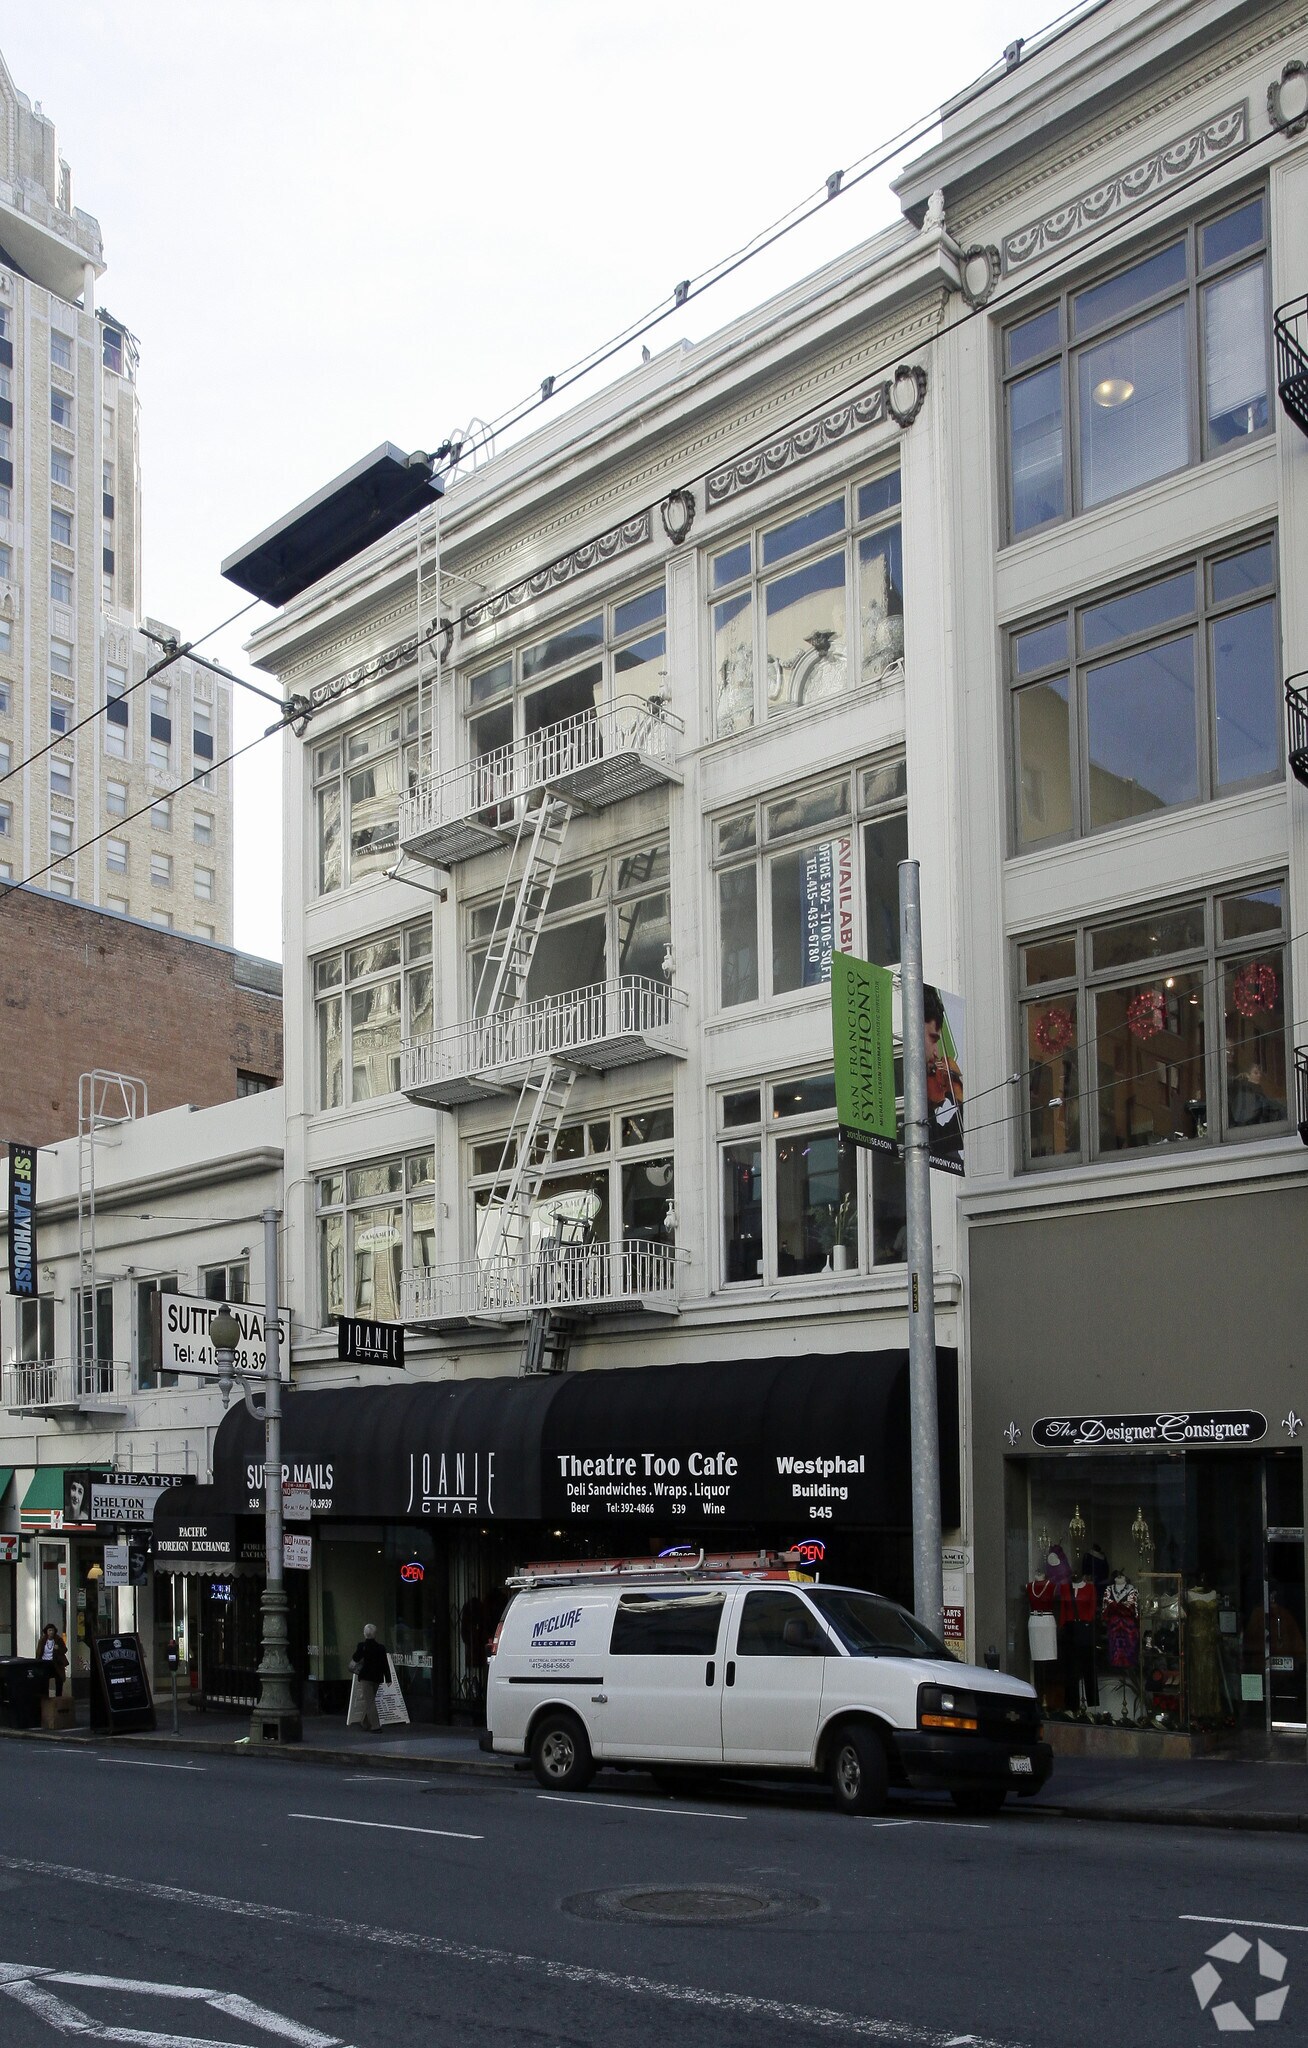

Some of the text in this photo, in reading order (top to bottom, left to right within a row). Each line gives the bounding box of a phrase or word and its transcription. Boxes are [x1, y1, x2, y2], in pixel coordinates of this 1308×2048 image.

[819, 843, 831, 881] OFFICE
[846, 970, 860, 1120] SAN FRANCISCO
[857, 972, 875, 1125] SYMPHONY
[15, 1147, 32, 1155] THE
[14, 1156, 31, 1181] SF
[14, 1181, 33, 1293] PLAYHOUSE
[173, 1343, 194, 1363] Tel:
[355, 1350, 389, 1360] CHAR
[1045, 1414, 1251, 1445] The Designer Consigner
[557, 1451, 739, 1477] Theatre Too Cafe
[776, 1454, 866, 1478] Westphal
[102, 1473, 183, 1487] THEATRE
[293, 1464, 334, 1490] NAILS
[282, 1488, 291, 1496] NO
[566, 1482, 731, 1500] Deli Sandwiches Wraps Liquor
[792, 1483, 849, 1500] Building
[93, 1496, 144, 1509] SHELTON
[249, 1499, 260, 1509] 535
[421, 1502, 479, 1514] CHAR
[570, 1502, 590, 1513] Beer
[671, 1503, 686, 1514] 539
[702, 1502, 726, 1514] Wine
[93, 1508, 145, 1520] THEATER
[808, 1506, 833, 1519] 545
[178, 1526, 208, 1538] PACIFIC
[157, 1540, 231, 1553] FOREIGN EXCHANGE
[284, 1535, 311, 1547] NO PARKING
[400, 1565, 424, 1582] OPEN
[946, 1609, 961, 1618] ARTS
